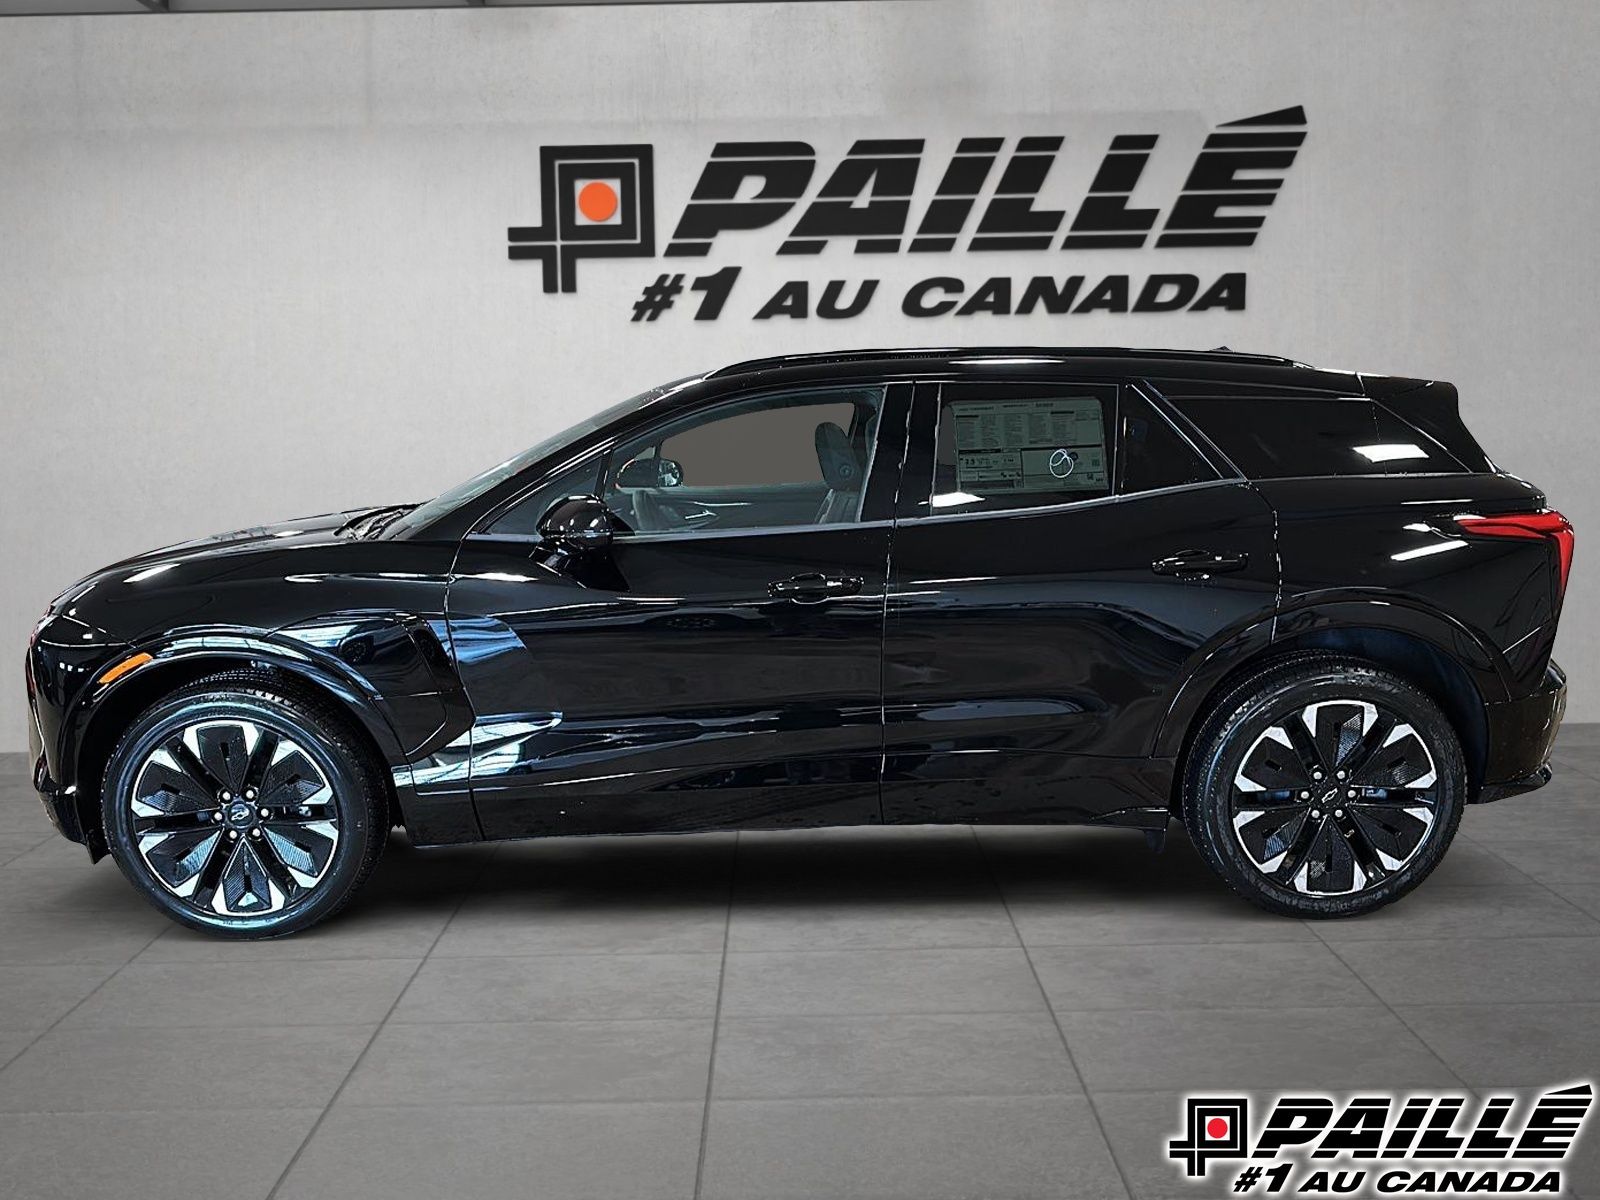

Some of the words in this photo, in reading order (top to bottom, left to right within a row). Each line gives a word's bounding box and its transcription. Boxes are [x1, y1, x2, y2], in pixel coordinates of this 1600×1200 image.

[663, 105, 1308, 257] PAILLÉ
[631, 266, 743, 321] #1
[752, 279, 881, 320] AU
[901, 272, 1247, 318] CANADA
